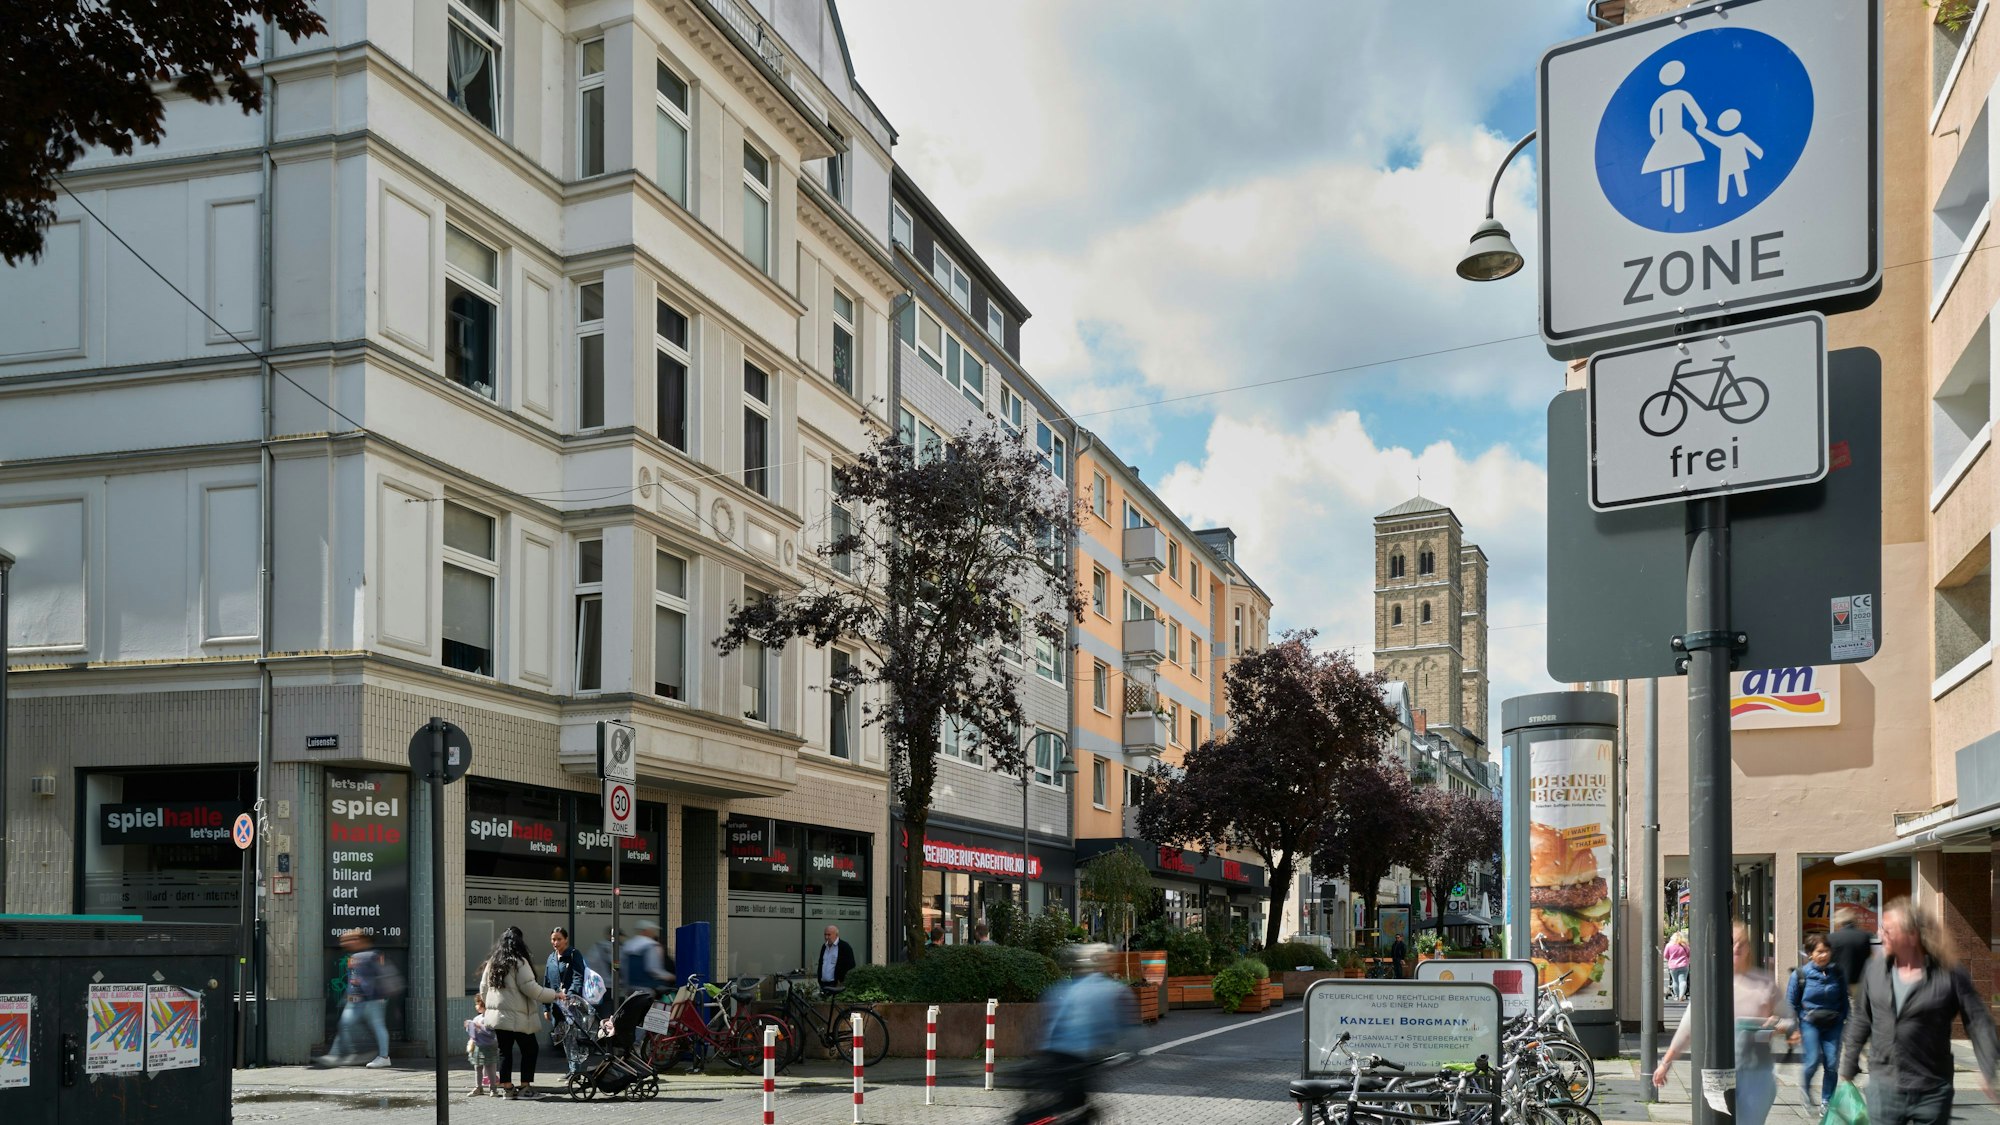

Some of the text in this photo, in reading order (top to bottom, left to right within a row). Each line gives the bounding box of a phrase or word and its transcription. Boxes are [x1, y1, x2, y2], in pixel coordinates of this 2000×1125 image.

[1624, 230, 1785, 305] ZONE
[1669, 436, 1739, 477] frei
[1528, 714, 1557, 723] STRÖER
[307, 737, 337, 747] Luisenstr.
[1535, 774, 1607, 788] DER NEU
[1534, 788, 1606, 802] BIG MAC
[331, 796, 398, 820] spiel
[615, 794, 627, 812] 30
[107, 807, 223, 833] spielhalle
[214, 828, 236, 840] pla
[331, 821, 400, 843] halle
[470, 817, 553, 842] spielhalle
[612, 823, 628, 833] ZONE
[1571, 827, 1590, 835] WANT
[578, 829, 648, 850] spielalle
[732, 830, 762, 843] spiel
[332, 851, 374, 864] games
[813, 854, 854, 870] spielhalle
[332, 868, 372, 881] billard
[332, 886, 358, 898] dart
[468, 895, 492, 906] games
[543, 896, 568, 907] internet
[600, 899, 612, 909] billa
[623, 900, 634, 910] dart
[638, 901, 658, 910] internet
[1807, 895, 1830, 918] d
[332, 903, 380, 916] internet
[382, 927, 401, 936] 1.00
[1448, 994, 1491, 1002] BERATUNG
[1340, 1016, 1469, 1026] KANZLEI BORGMANN
[1336, 1033, 1398, 1041] RHTSANWALT
